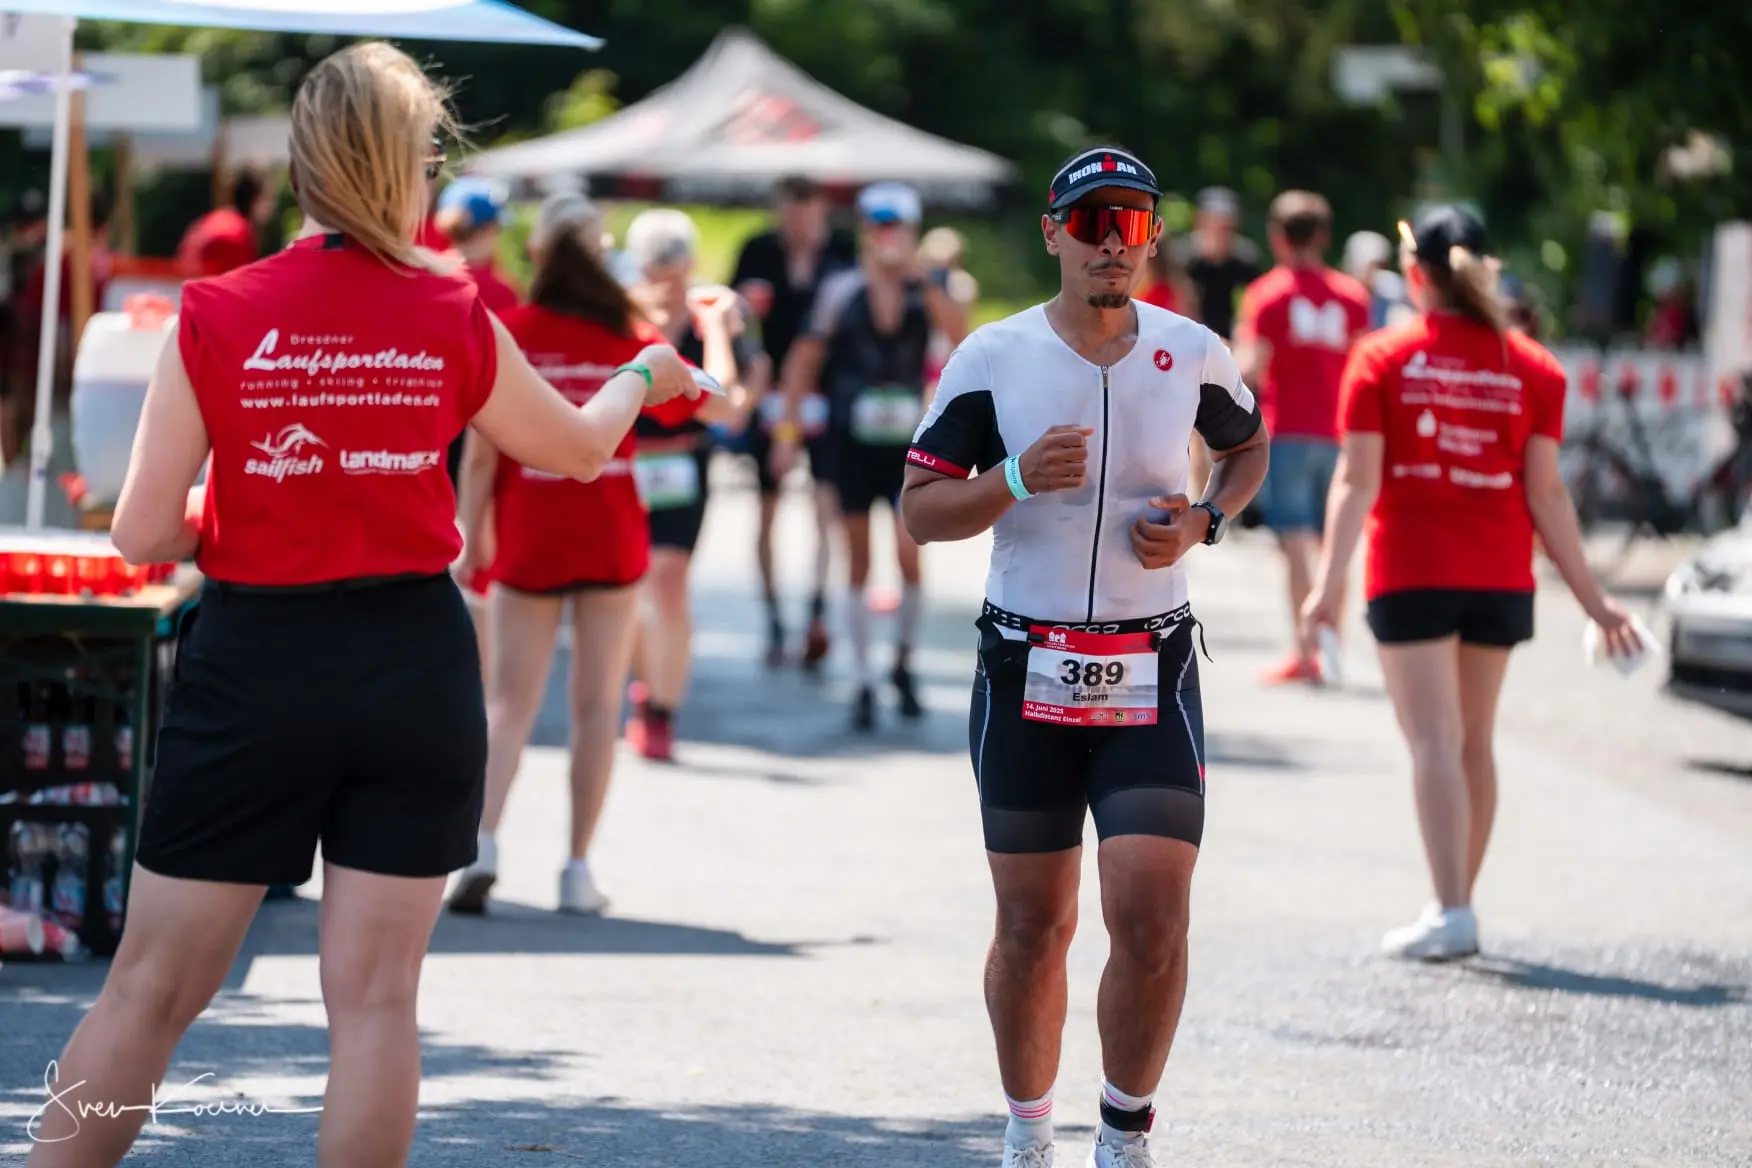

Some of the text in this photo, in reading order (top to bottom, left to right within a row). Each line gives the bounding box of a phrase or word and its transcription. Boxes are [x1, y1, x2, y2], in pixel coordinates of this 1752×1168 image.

[1068, 154, 1138, 185] IRONMAN
[243, 328, 445, 376] Laufsportladen
[290, 333, 354, 345] Dresdner
[240, 378, 299, 390] running
[244, 454, 324, 483] sailfish
[1060, 659, 1124, 687] 389
[1072, 692, 1109, 702] Eslam
